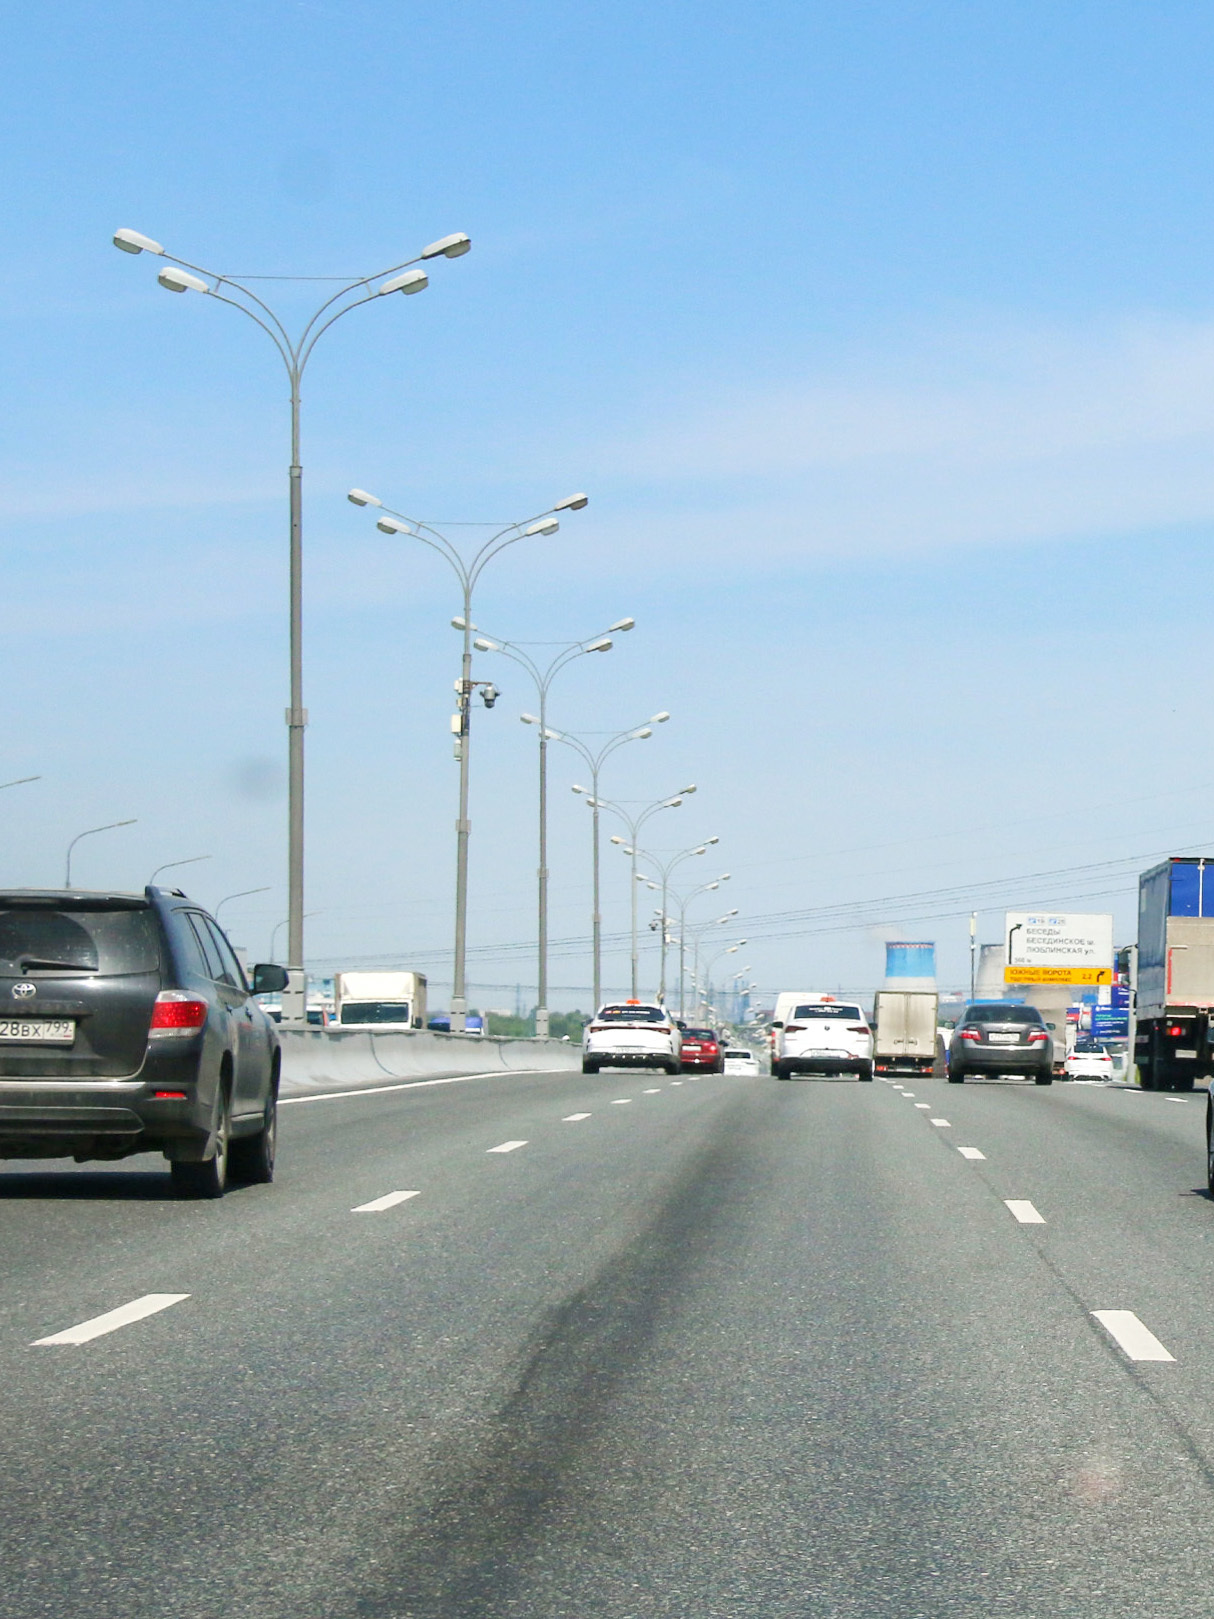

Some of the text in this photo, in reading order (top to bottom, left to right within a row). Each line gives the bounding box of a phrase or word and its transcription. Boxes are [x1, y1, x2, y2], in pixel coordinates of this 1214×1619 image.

[1026, 928, 1061, 936] БЕСЕДЫ
[1026, 937, 1085, 945] БЕСЕДИНСКОЕ
[1026, 946, 1083, 954] ЛЮБЛИНСКАЯ
[45, 1021, 69, 1033] 799
